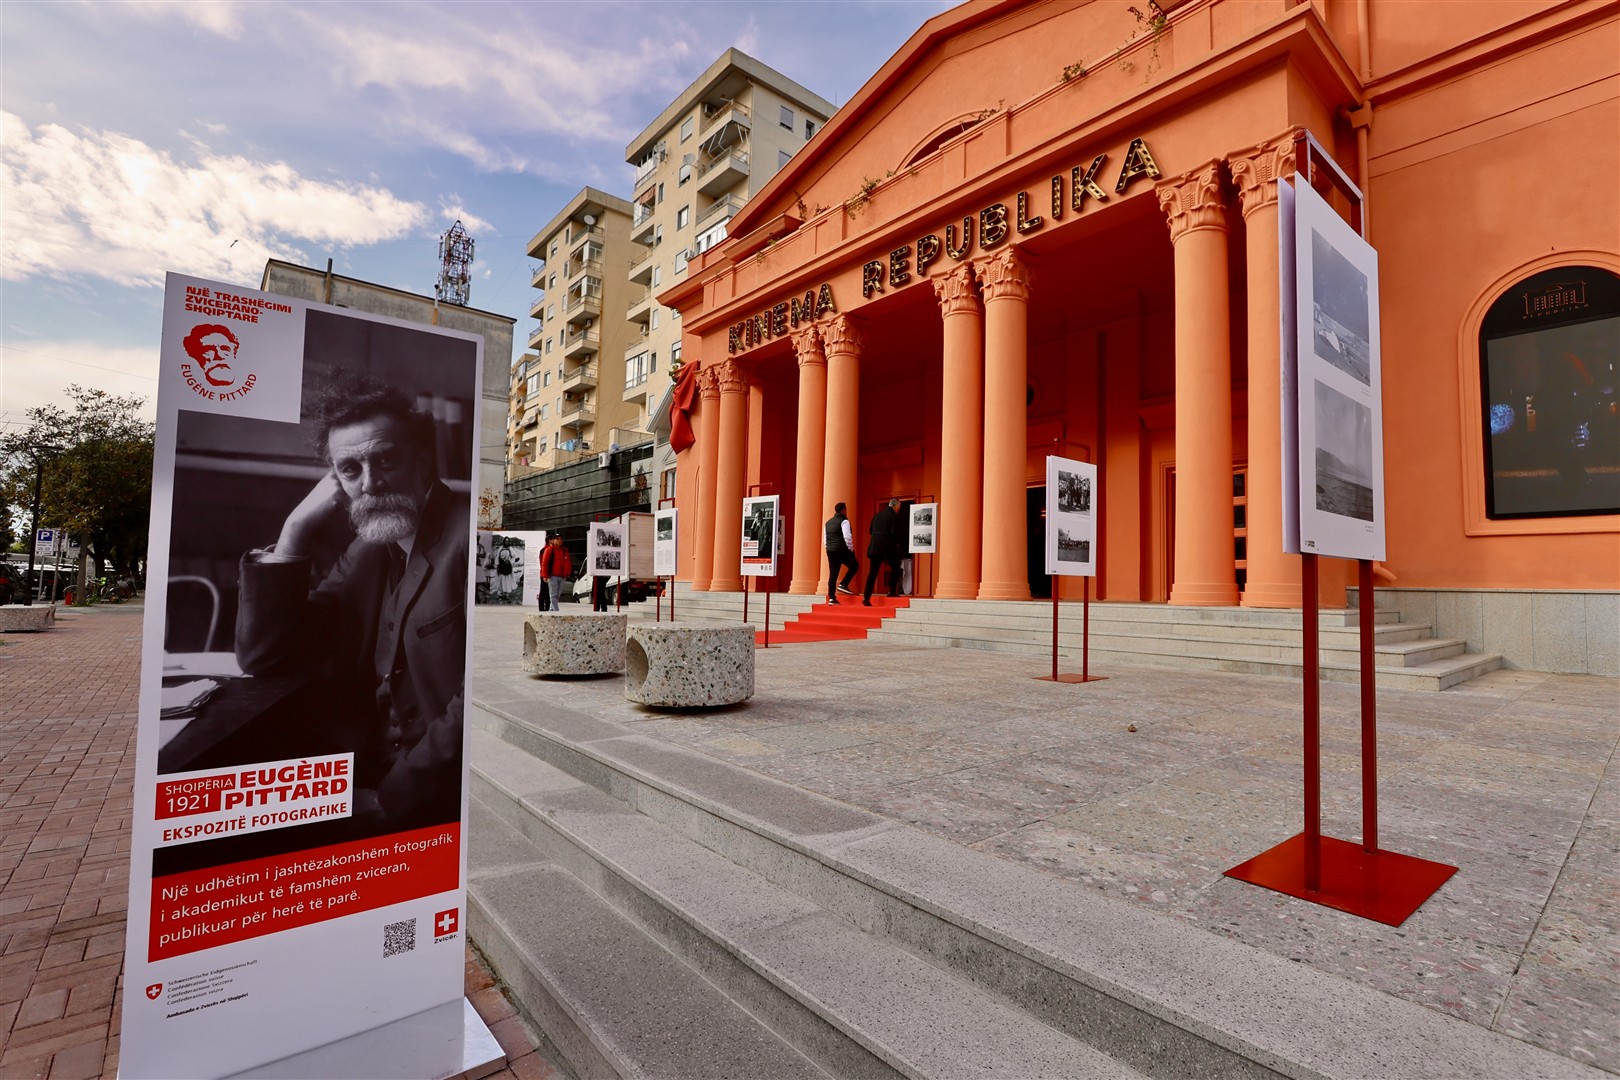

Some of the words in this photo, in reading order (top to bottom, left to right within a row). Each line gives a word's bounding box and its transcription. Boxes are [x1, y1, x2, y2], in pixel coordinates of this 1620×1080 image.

[728, 282, 838, 354] KINEMA
[862, 137, 1162, 299] REPUBLIKA
[185, 294, 263, 315] ZVICERANO-
[185, 303, 258, 323] SHQIPTARE
[186, 286, 210, 297] NJË
[214, 291, 292, 313] TRASHËGIMI
[219, 373, 257, 402] PITTARD
[41, 531, 50, 540] P
[165, 777, 234, 796] SHQIPËRIA
[240, 759, 349, 788] EUGÈNE
[167, 793, 210, 813] 1921
[225, 778, 348, 810] PITTARD
[163, 815, 246, 842] EKSPOZITË
[251, 802, 347, 828] FOTOGRAFIKE
[162, 884, 189, 901] Një
[195, 872, 260, 894] udhëtim
[265, 868, 269, 880] i
[273, 847, 389, 881] jashtëzakonshëm
[393, 833, 453, 854] fotografik
[161, 910, 165, 922] i
[171, 891, 264, 920] akademikut
[269, 886, 284, 899] të
[289, 873, 351, 895] famshëm
[355, 862, 411, 881] zviceran,
[159, 918, 237, 947] publikuar
[241, 911, 268, 929] për
[272, 901, 304, 919] herë
[309, 898, 323, 910] të
[328, 890, 361, 909] parë.
